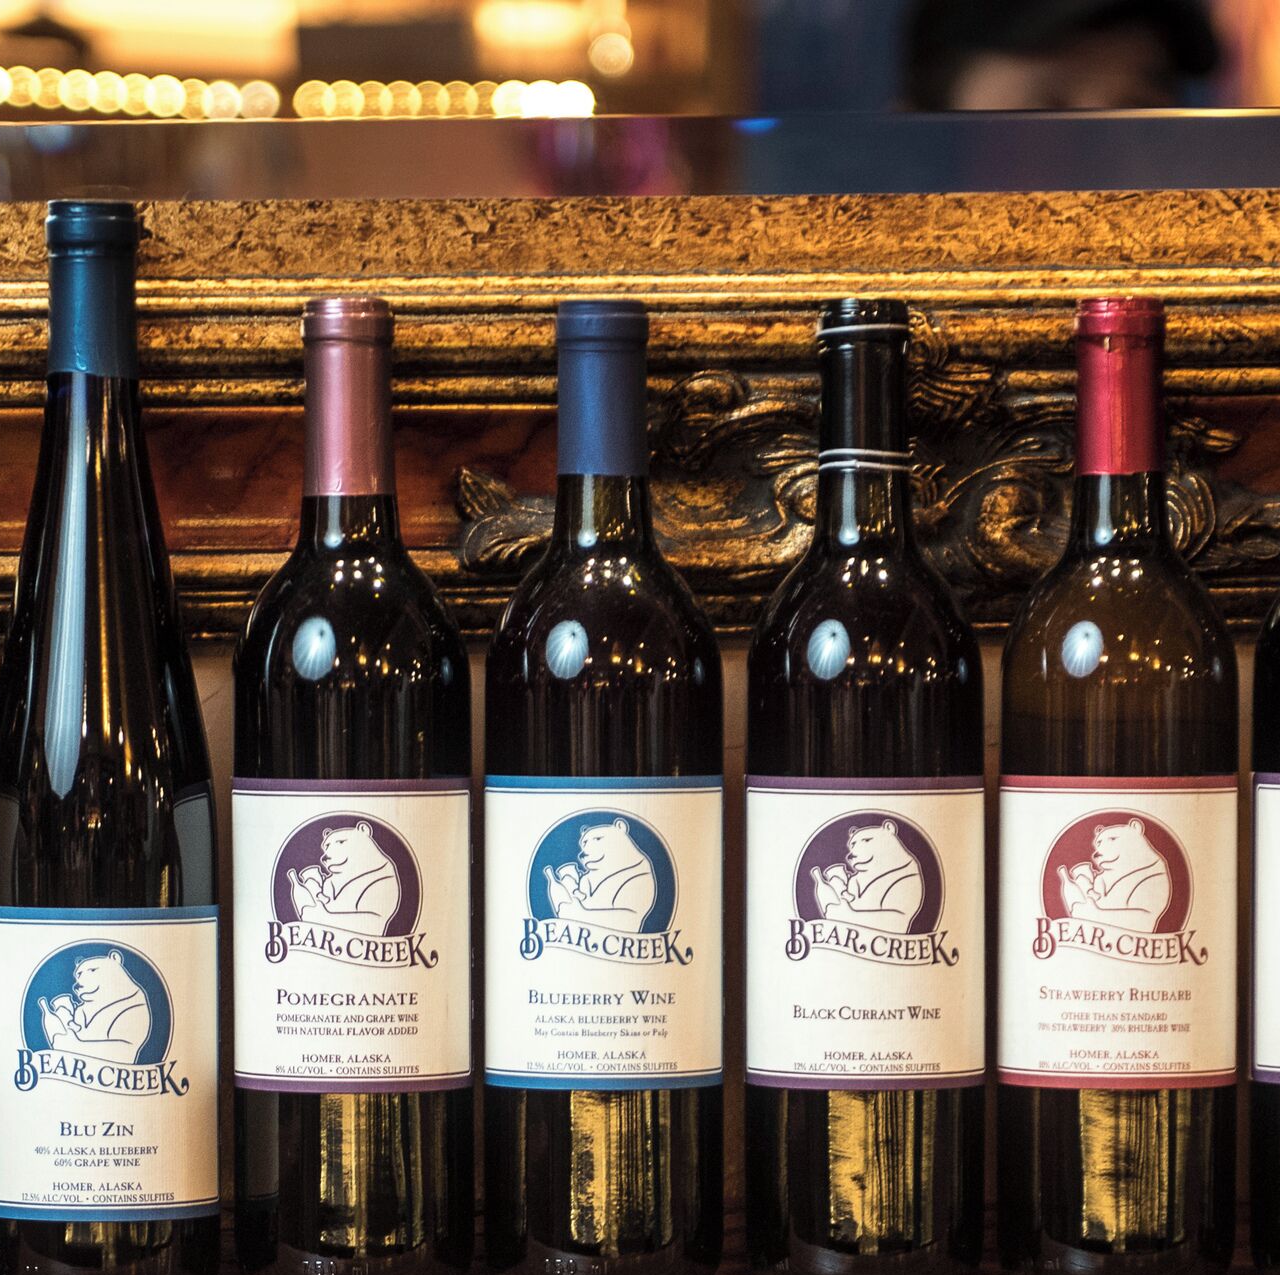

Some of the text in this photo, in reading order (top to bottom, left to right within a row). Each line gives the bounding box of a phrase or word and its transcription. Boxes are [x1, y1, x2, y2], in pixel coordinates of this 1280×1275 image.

[265, 922, 439, 969] BEAR CREEK
[519, 918, 693, 966] BEAR CREEK
[785, 918, 959, 967] BEAR CREEK
[1032, 915, 1208, 966] BEAR CREEK
[276, 988, 419, 1006] POMEGRANATE
[528, 989, 676, 1005] BLUEBERRY WINE
[1039, 985, 1192, 1002] STRAWBERRY RHUBARB
[276, 1013, 419, 1023] POMEGRANATE AND GRAPE WINE
[793, 1004, 941, 1020] BLACK CURRANT WINE
[535, 1015, 668, 1024] ALASKA BLUEBERRY WINE
[276, 1026, 419, 1036] WITH NATURAL FLAVOR ADDED
[302, 1054, 391, 1064] HOMER, ALASKA
[602, 1051, 647, 1060] ALASKA
[870, 1051, 913, 1061] ALASKA
[1115, 1050, 1160, 1059] ALASKA
[13, 1049, 190, 1097] BEAR CREEK
[60, 1121, 134, 1137] BLU ZIN
[34, 1146, 159, 1156] 40% ALASKA BLUEBERRY
[54, 1158, 141, 1167] 60% GRAPE WINE
[52, 1182, 143, 1192] HOMER, ALASKA
